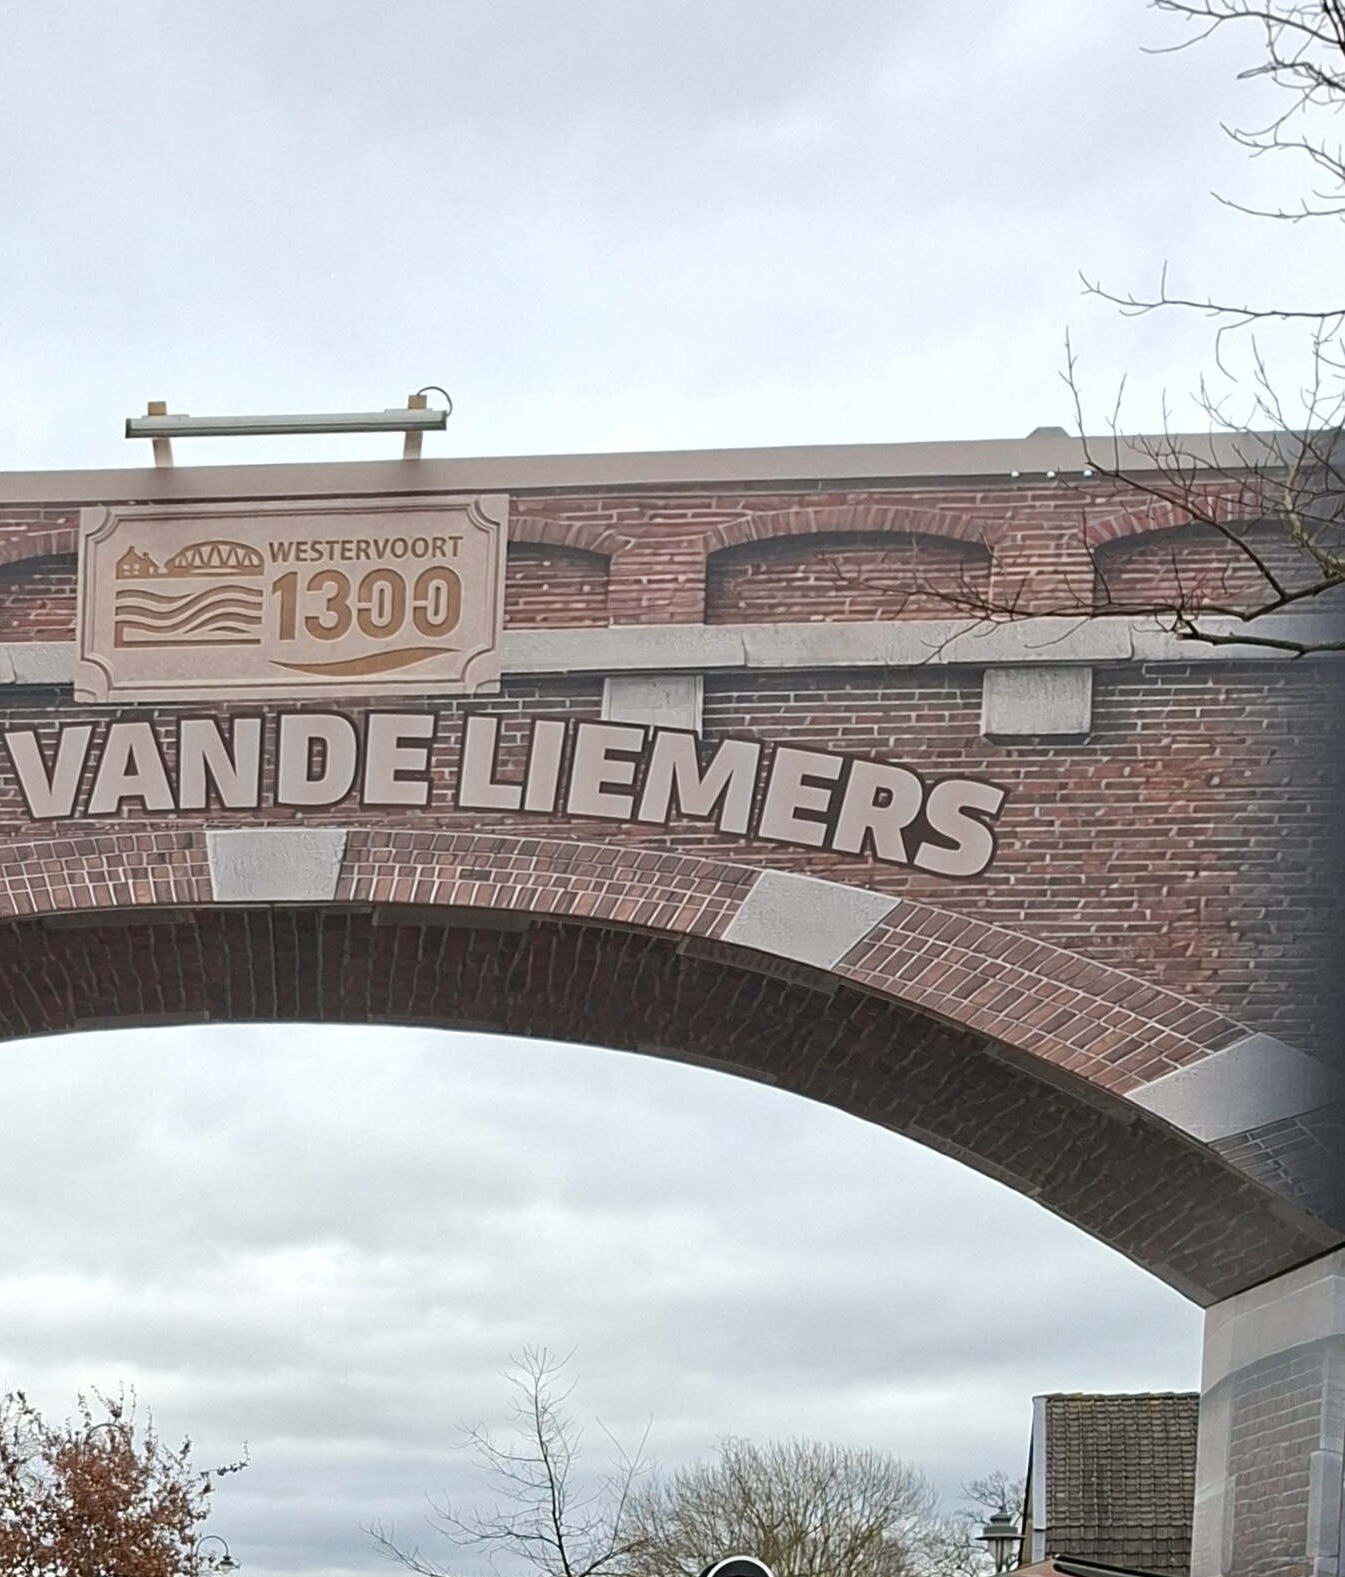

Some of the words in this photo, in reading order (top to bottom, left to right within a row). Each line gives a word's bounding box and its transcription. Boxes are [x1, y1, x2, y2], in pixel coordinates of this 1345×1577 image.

[268, 536, 464, 564] WESTERVOORT
[271, 565, 464, 642] 1300
[3, 714, 262, 820] VAN
[275, 708, 437, 809] DE
[456, 712, 1007, 879] LIEMERS
